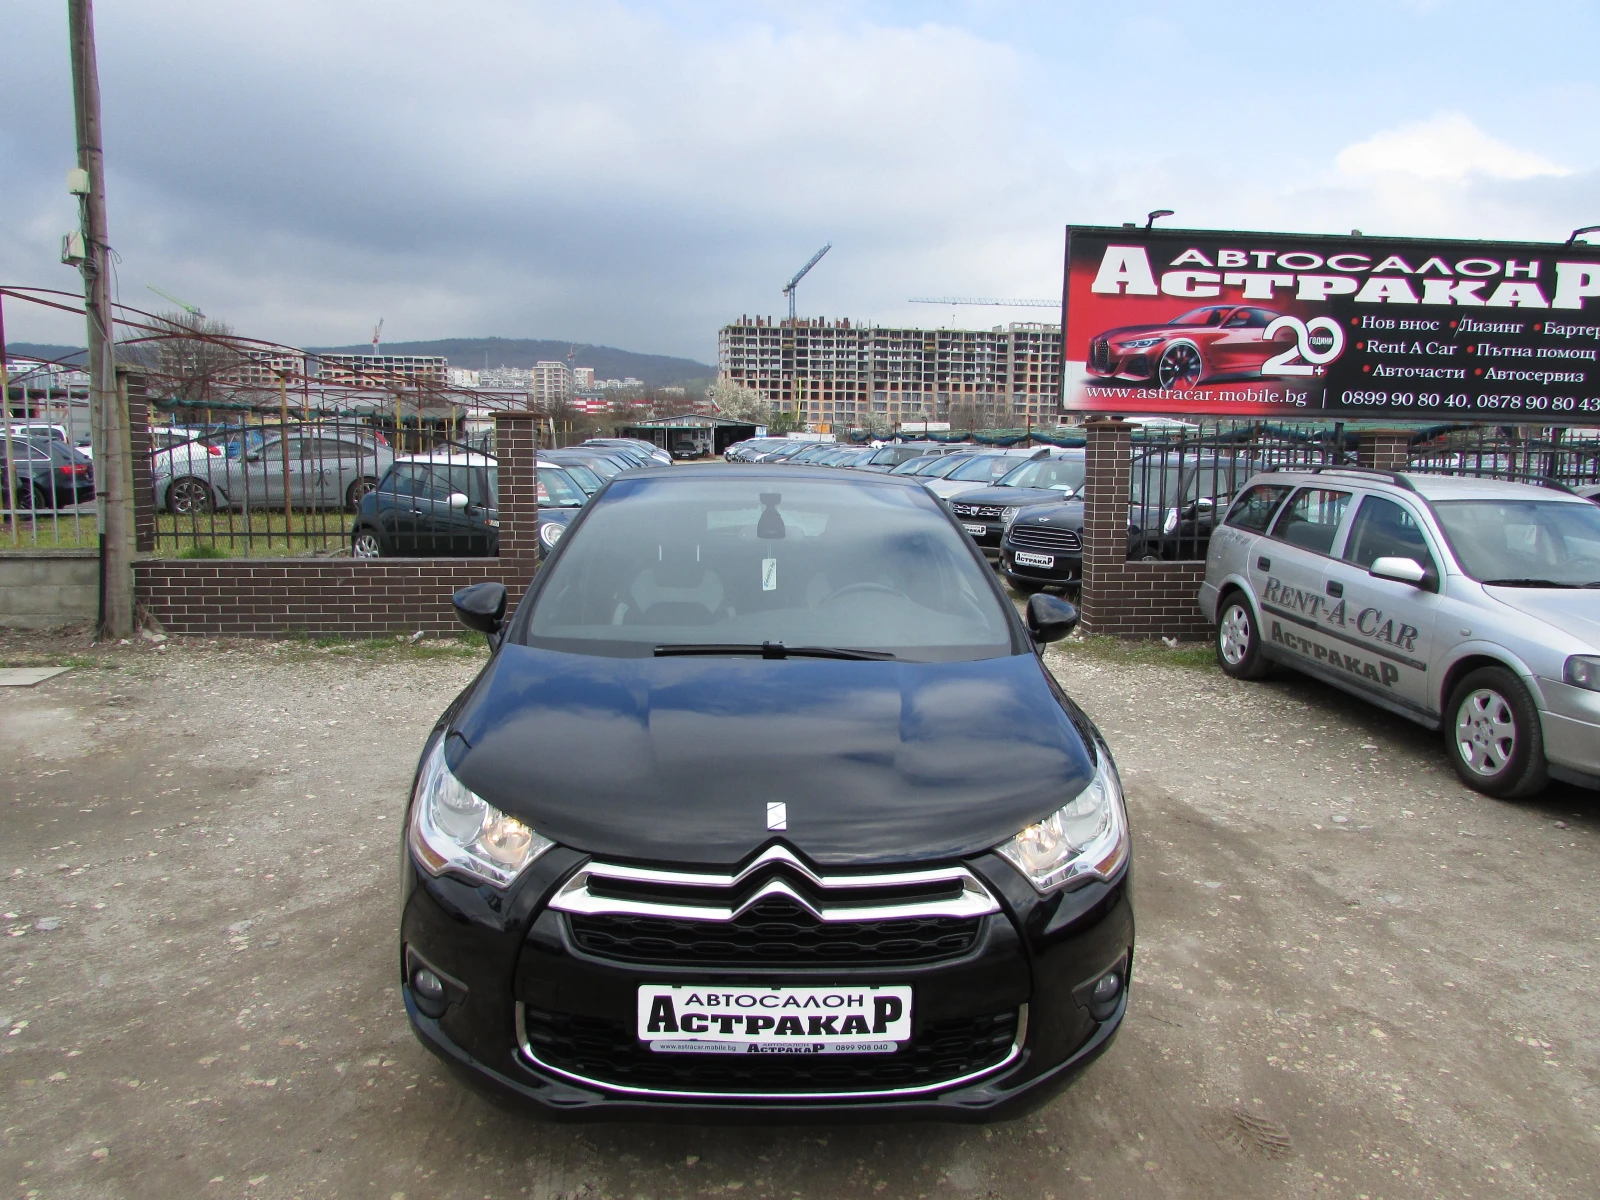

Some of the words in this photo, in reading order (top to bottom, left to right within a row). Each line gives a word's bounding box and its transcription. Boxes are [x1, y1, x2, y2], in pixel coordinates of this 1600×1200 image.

[1169, 248, 1540, 278] АВТОСАЛОН
[1361, 315, 1395, 329] Нов
[1399, 320, 1440, 331] внос
[1458, 318, 1524, 334] Лизинг
[1309, 336, 1333, 345] ГОДИНИ
[1365, 340, 1406, 354] Rent
[1409, 341, 1423, 355] A
[1425, 341, 1458, 356] Car
[1476, 343, 1533, 358] Пътна
[1536, 348, 1596, 362] помощ
[1372, 363, 1466, 379] Авточасти
[1484, 367, 1585, 385] Автосервиз
[1086, 387, 1307, 407] www.astracar.mobile.bg
[1341, 390, 1387, 406] 0899
[1391, 392, 1414, 406] 90
[1417, 392, 1440, 407] 80
[1443, 394, 1471, 409] 40,
[1477, 394, 1521, 409] 0878
[1525, 395, 1548, 410] 90
[1552, 396, 1574, 411] 80
[1261, 576, 1419, 652] RENT-A-CAR
[1271, 620, 1399, 687] АСТРАКАР
[684, 993, 864, 1008] АВТОСАЛОН
[647, 994, 903, 1035] АСТРАКАР
[659, 1043, 737, 1052] www.astracar.mobile.bg
[747, 1043, 826, 1053] АСТРАКАР
